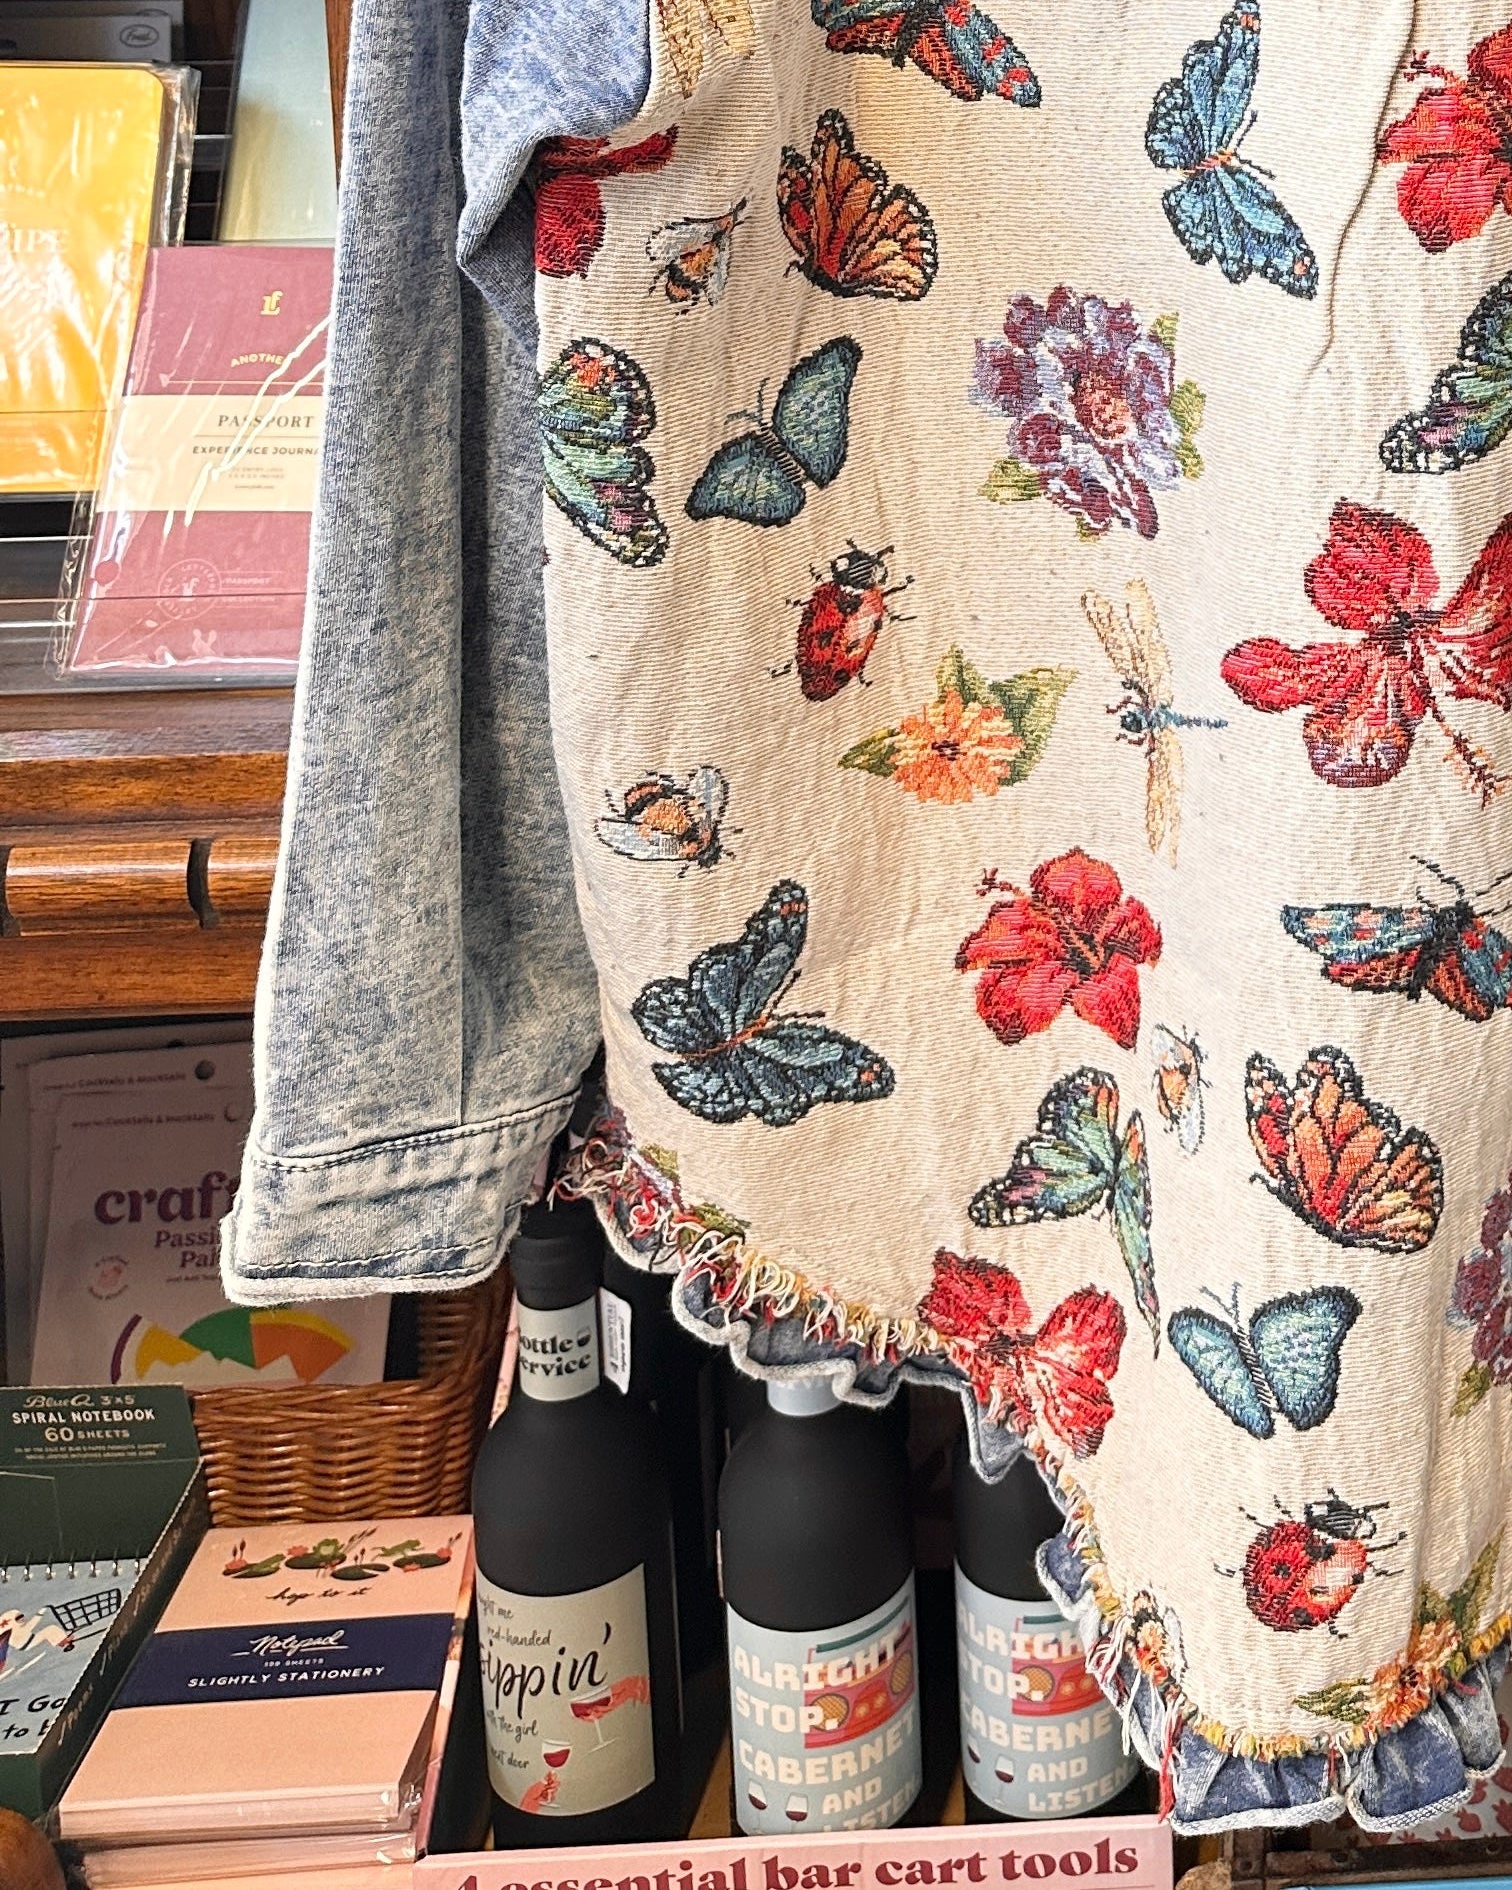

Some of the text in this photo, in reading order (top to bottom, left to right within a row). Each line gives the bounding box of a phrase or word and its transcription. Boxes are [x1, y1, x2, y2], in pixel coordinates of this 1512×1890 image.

[230, 353, 285, 368] ANOTHE
[154, 1226, 220, 1248] Passi
[519, 1334, 574, 1354] ottle
[12, 1408, 156, 1424] SPIRAL NOTEBOOK
[44, 1426, 130, 1442] 60 SHEETS
[734, 1627, 900, 1691] ALRIGHT
[187, 1666, 385, 1688] SLIGHTLY STATIONERY
[735, 1685, 838, 1734] STOP.
[738, 1705, 913, 1785] CABERNET
[1027, 1756, 1089, 1784] AND
[821, 1776, 883, 1814] AND
[762, 1855, 862, 1890] bar
[874, 1851, 988, 1887] cart
[998, 1837, 1139, 1881] tools
